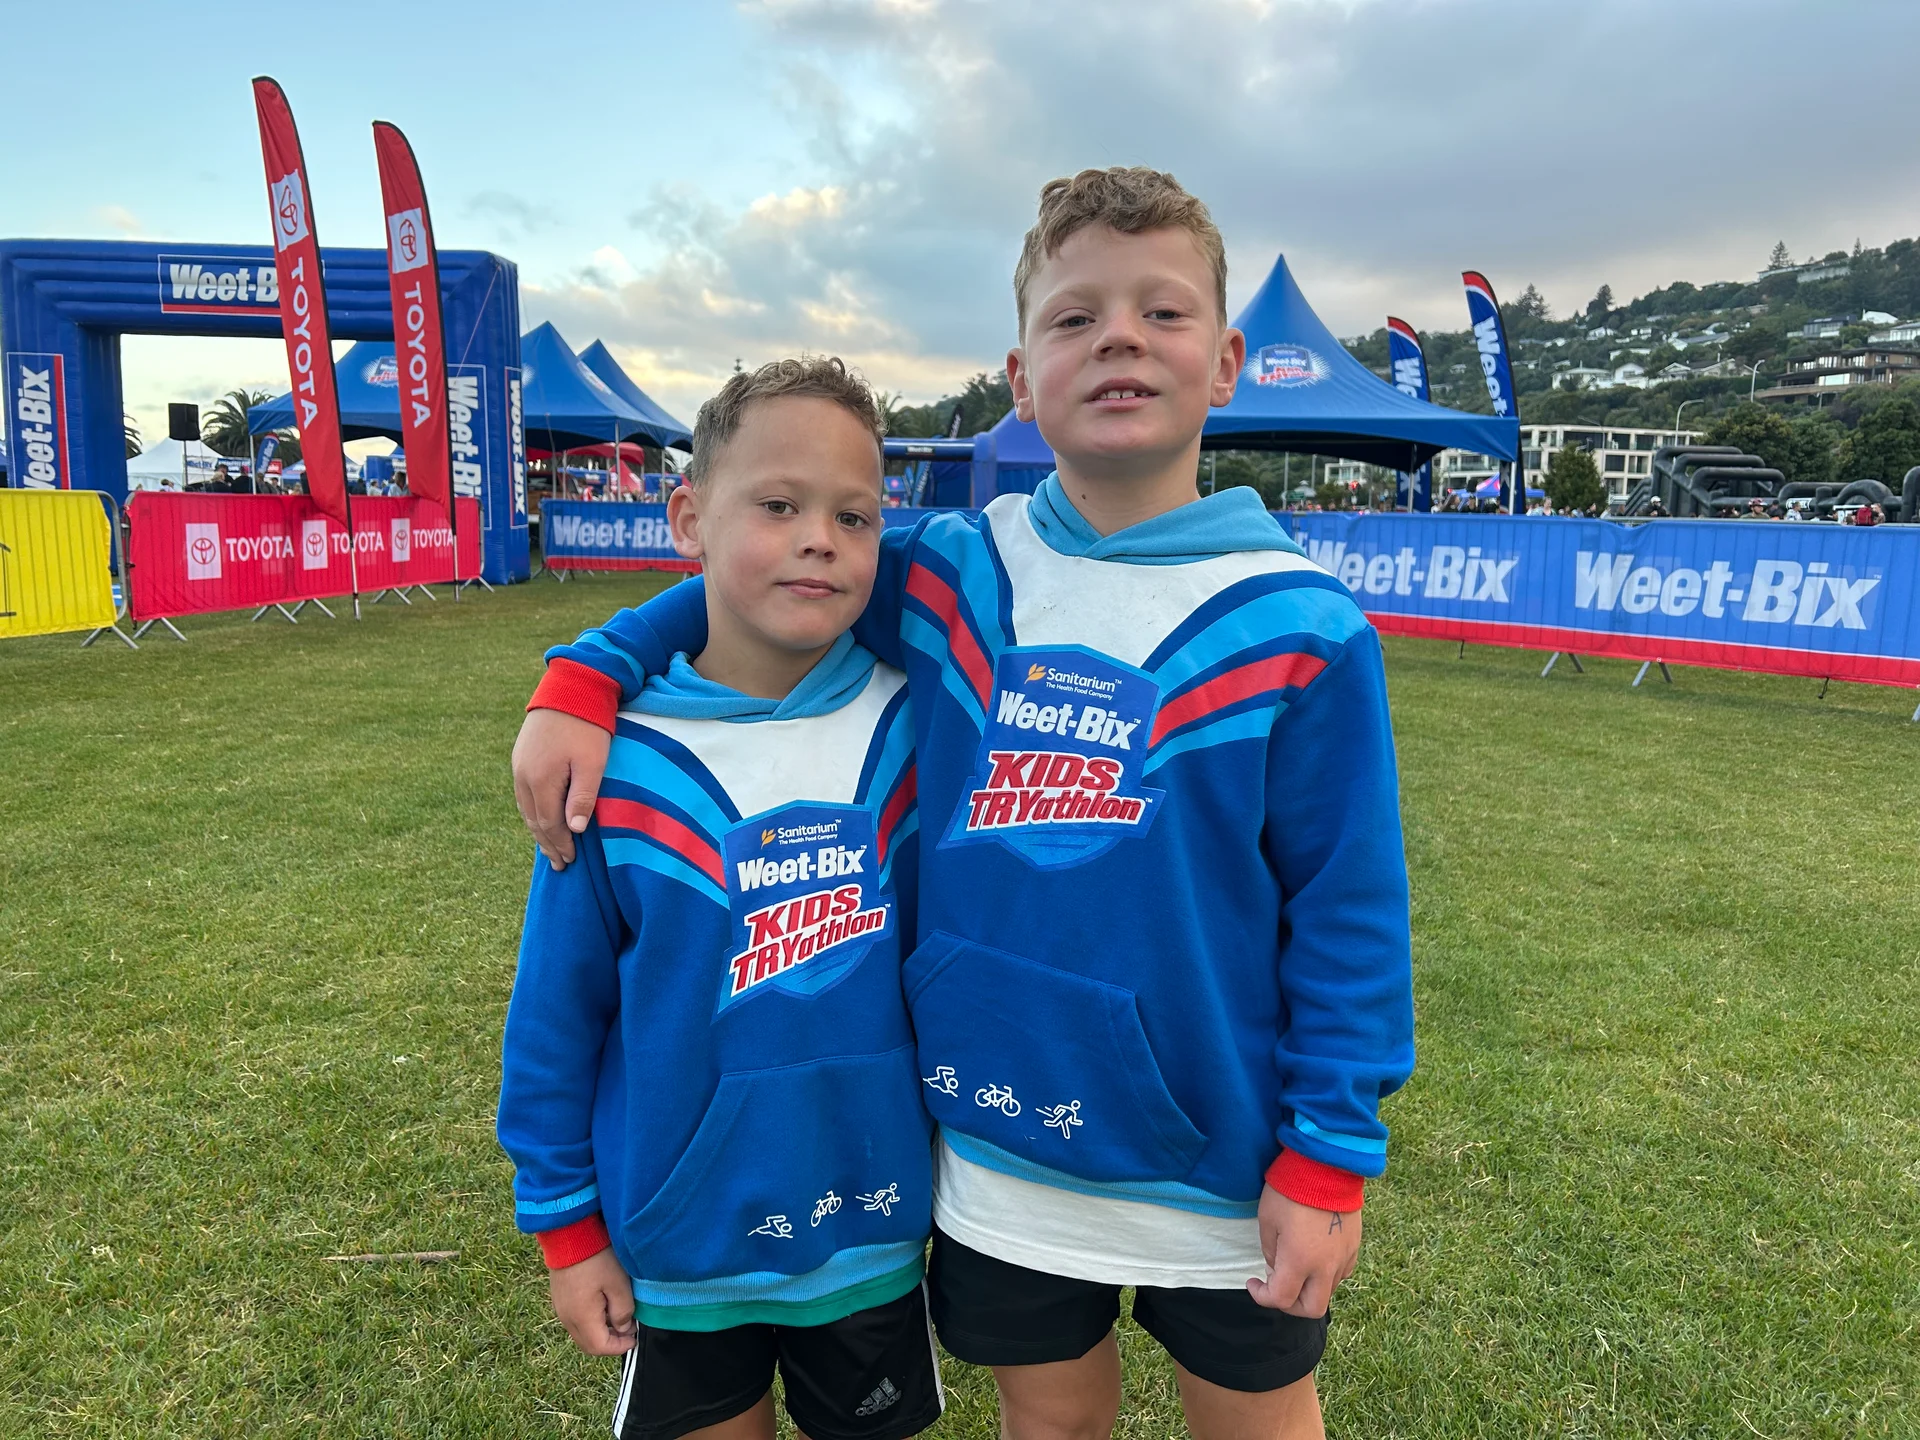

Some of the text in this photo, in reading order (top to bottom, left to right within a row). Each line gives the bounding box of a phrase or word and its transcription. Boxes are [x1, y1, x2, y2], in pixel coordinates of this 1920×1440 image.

[170, 264, 280, 303] Weet-B
[290, 256, 318, 430] TOYOTA
[404, 281, 431, 429] TOYOTA
[1473, 316, 1508, 418] Weet
[447, 376, 482, 498] Weet-Bi
[225, 535, 295, 562] TOYOTA
[331, 531, 385, 554] TOYOTA
[412, 528, 454, 549] TOYOTA
[1574, 550, 1881, 630] Weet-Bix
[1045, 681, 1113, 700] The Health Food Company
[996, 689, 1140, 750] Weet-Bix
[988, 752, 1120, 791] KIDS
[968, 789, 1143, 828] TRYathlon
[737, 845, 866, 892] Weet-Bix
[746, 885, 862, 948] KIDS
[731, 909, 885, 993] TRYathlon
[1328, 1211, 1342, 1235] A
